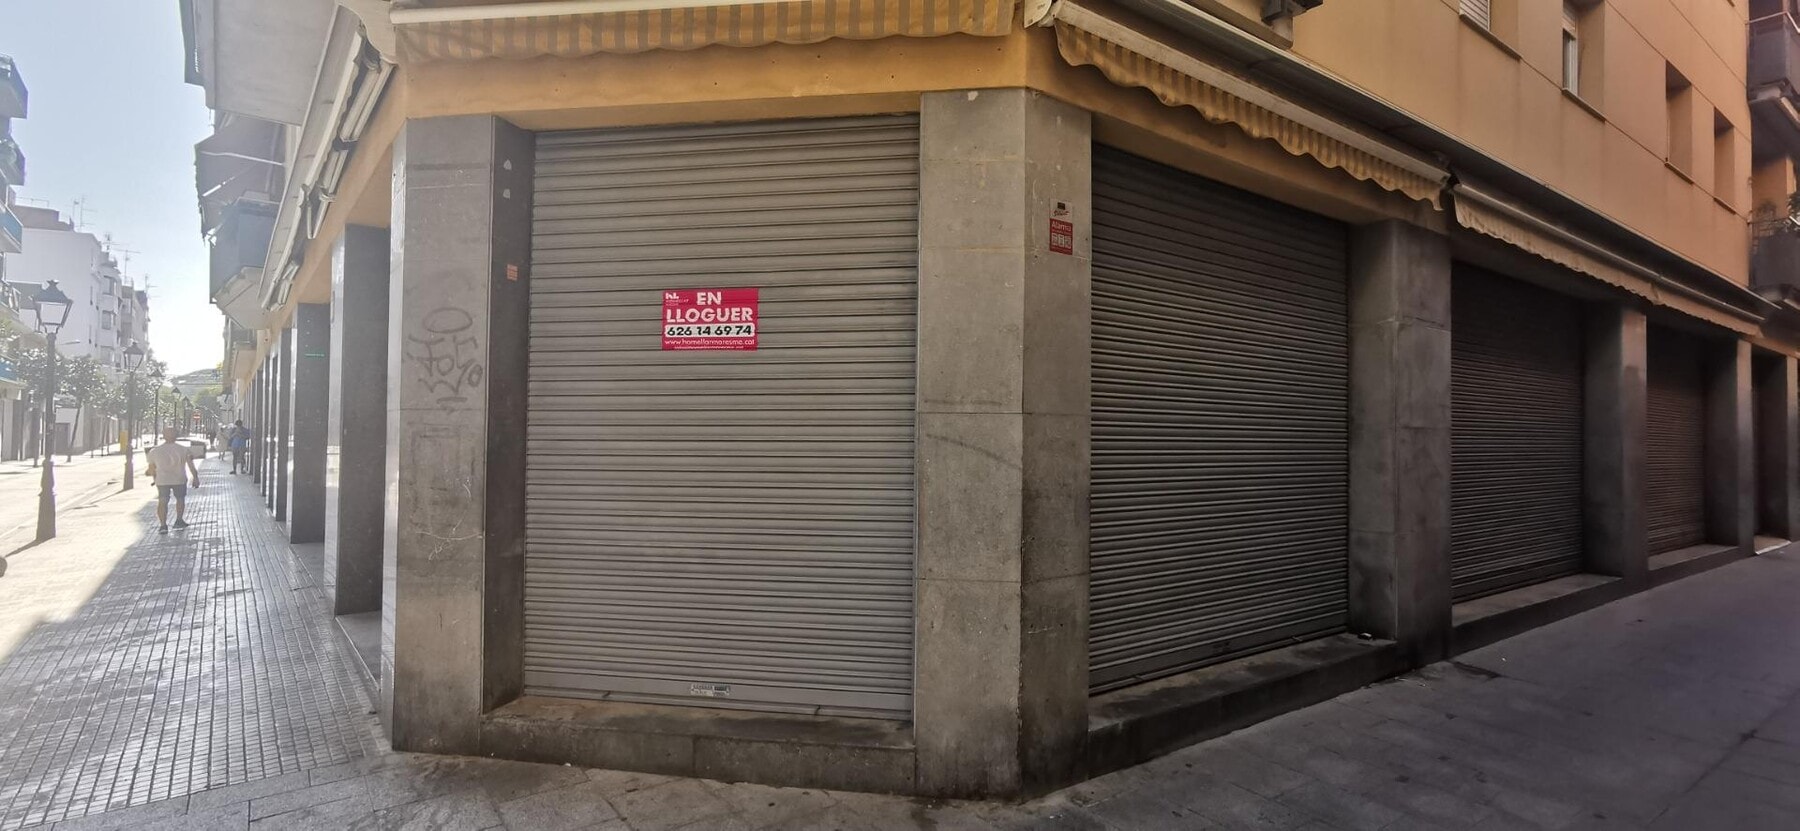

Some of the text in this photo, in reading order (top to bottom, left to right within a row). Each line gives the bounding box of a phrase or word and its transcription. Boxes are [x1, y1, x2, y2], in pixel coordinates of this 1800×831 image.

[697, 292, 722, 305] EN
[666, 308, 753, 322] LLOGUER
[667, 325, 752, 335] 626 14 69 74
